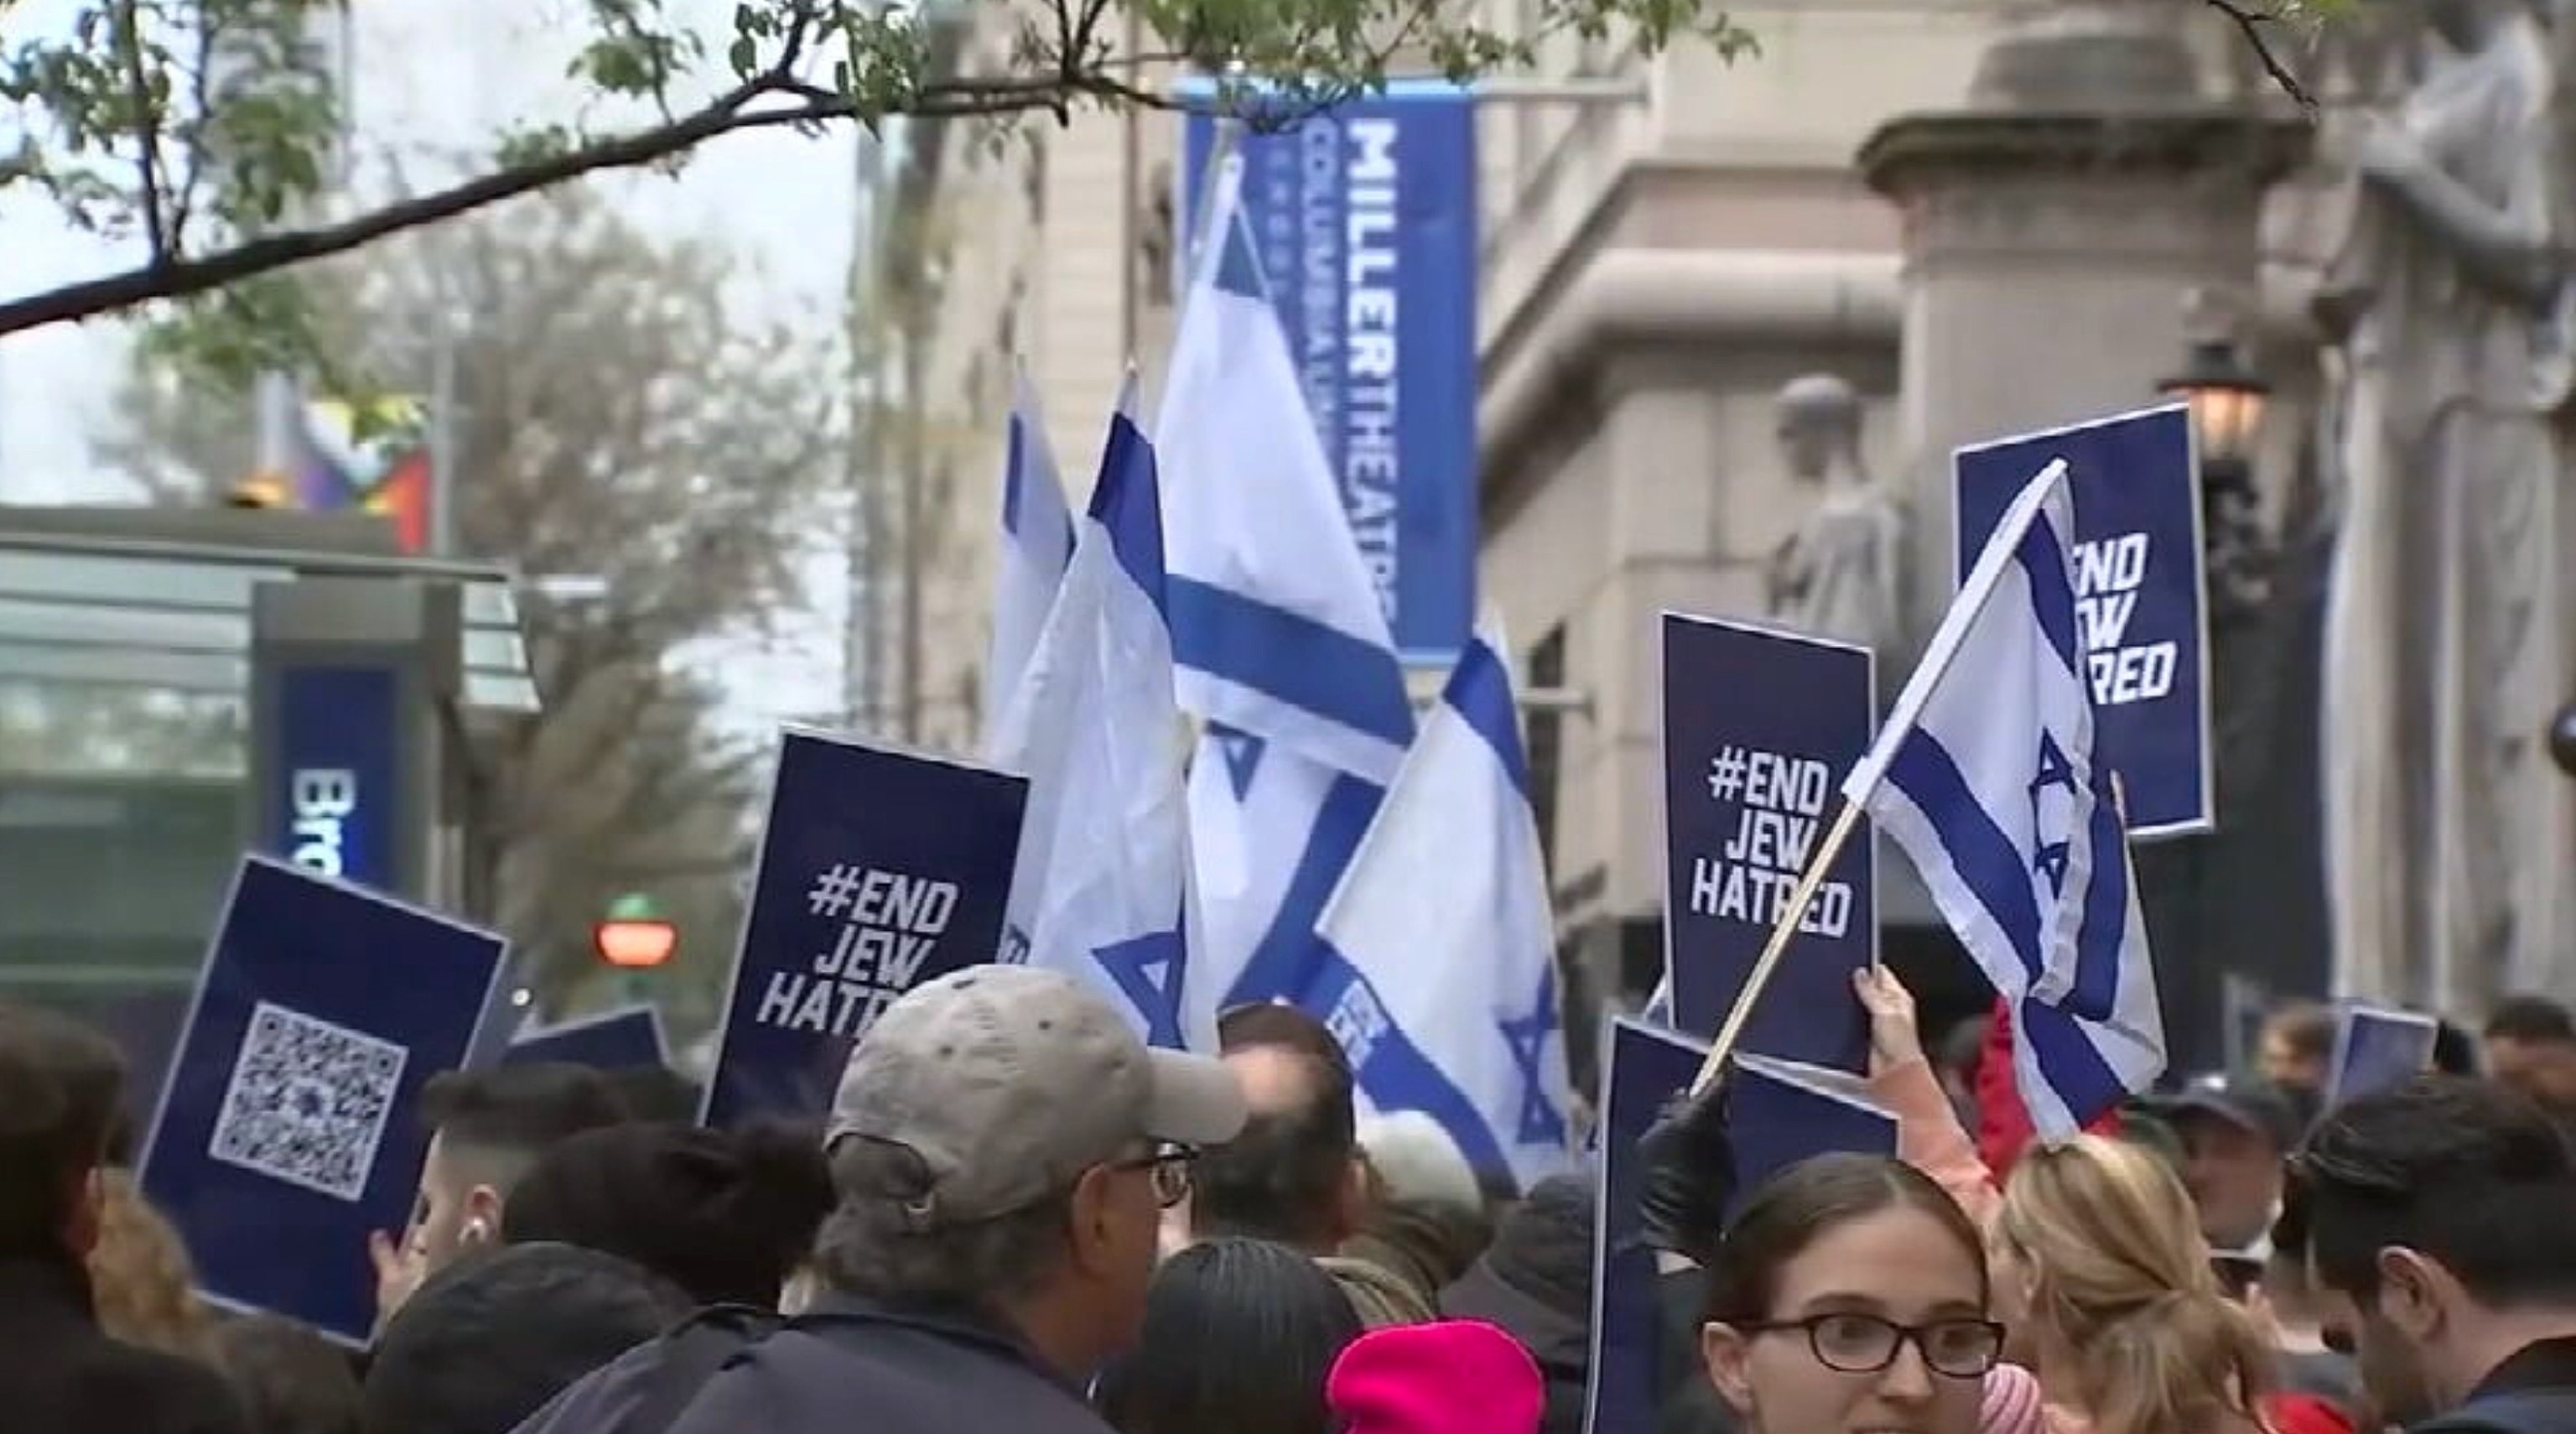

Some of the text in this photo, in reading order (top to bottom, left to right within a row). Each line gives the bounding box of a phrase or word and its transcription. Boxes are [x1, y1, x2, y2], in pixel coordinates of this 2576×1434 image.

[2072, 532, 2149, 599] ND
[1708, 745, 1829, 817] #END
[1725, 808, 1819, 872] JEW
[808, 863, 958, 933] #END
[815, 923, 937, 989] JEW
